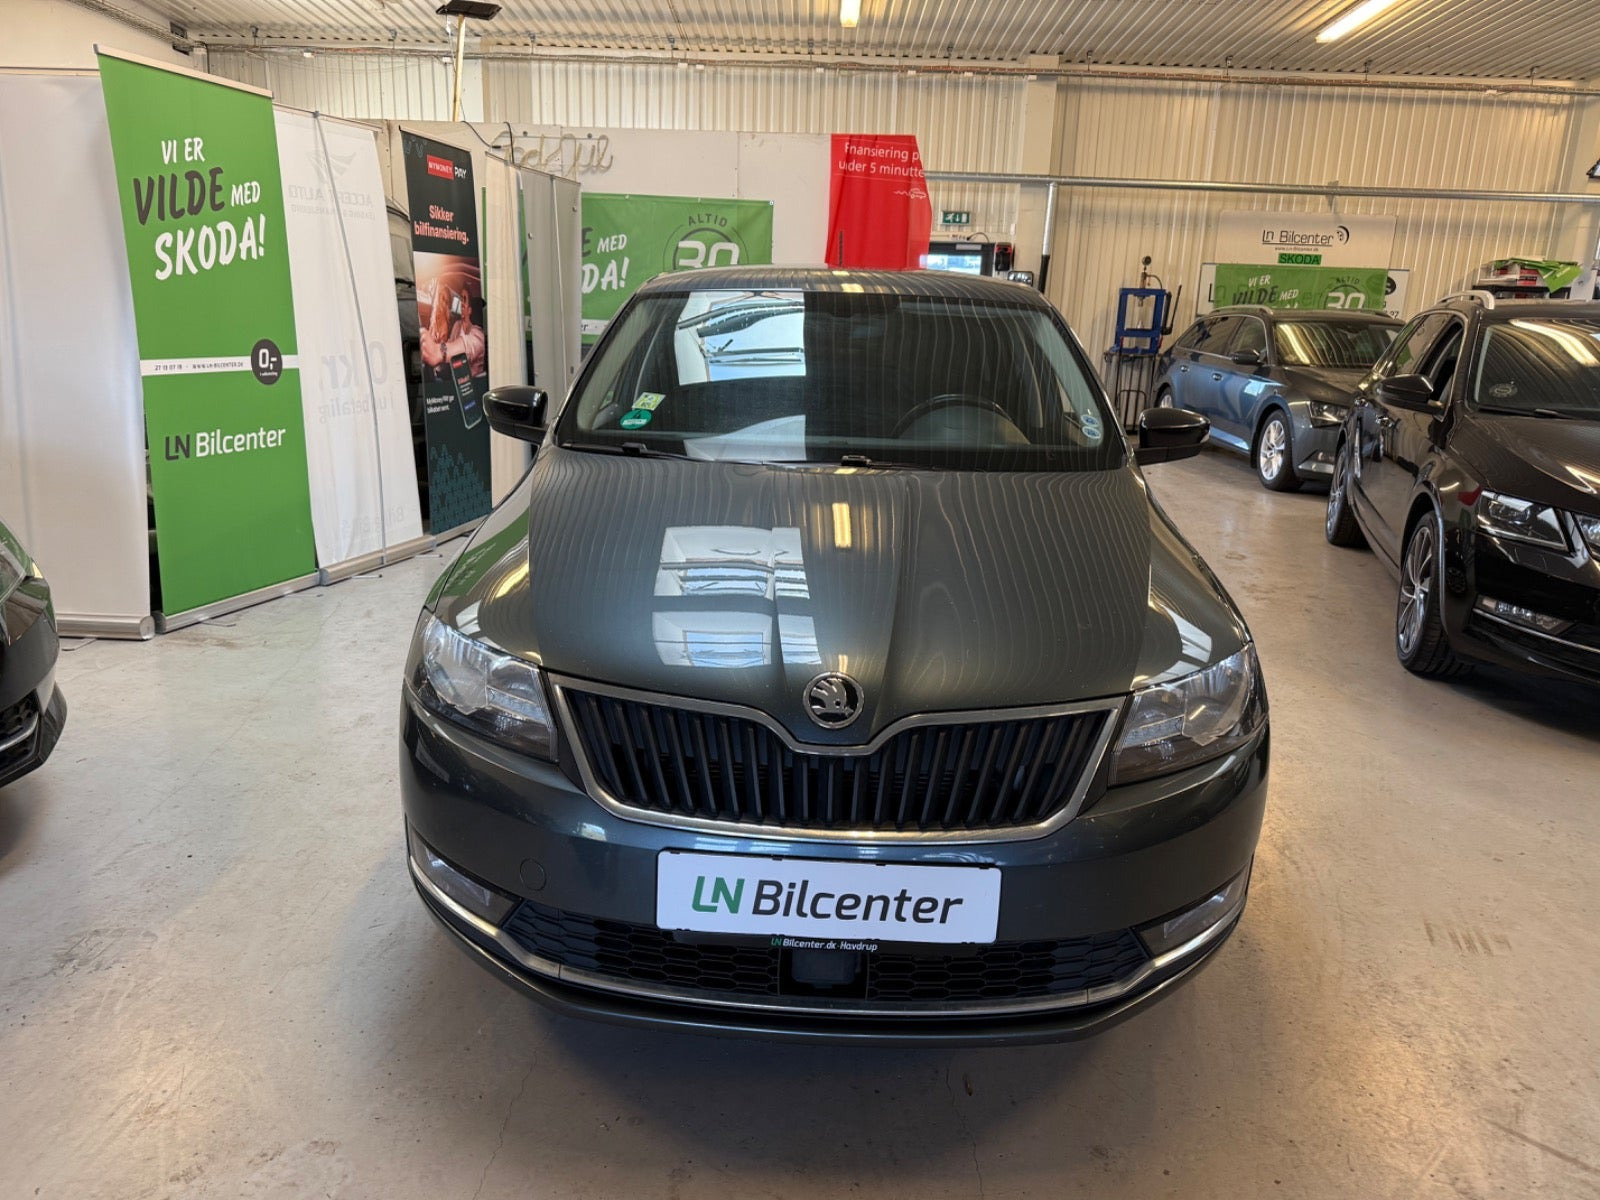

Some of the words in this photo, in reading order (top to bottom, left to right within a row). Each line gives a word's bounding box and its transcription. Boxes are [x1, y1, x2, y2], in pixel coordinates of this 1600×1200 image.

[161, 139, 177, 165] VI
[184, 136, 205, 162] ER
[844, 142, 909, 163] Fnansiering
[912, 151, 921, 163] p
[838, 159, 867, 172] uder
[870, 162, 877, 174] 5
[880, 163, 924, 178] minutte
[133, 166, 225, 226] VILDE
[231, 180, 261, 207] MED
[429, 205, 454, 222] Sikker
[688, 213, 728, 228] ALTID
[414, 221, 470, 245] bilfinansiering.
[1279, 230, 1334, 244] Bilcenter
[155, 213, 266, 281] SKODA!
[597, 234, 628, 254] MED
[1280, 253, 1321, 265] SKODA
[581, 257, 630, 294] DA!
[1248, 277, 1257, 288] VI
[1259, 274, 1271, 285] ER
[1280, 289, 1299, 301] MED
[165, 434, 190, 460] LN
[196, 427, 286, 457] Bilcenter
[691, 875, 745, 914] LN
[752, 879, 963, 924] Bilcenter
[771, 937, 783, 946] LN
[783, 938, 837, 949] Bilcenter.dk
[839, 941, 878, 952] Havdrup
